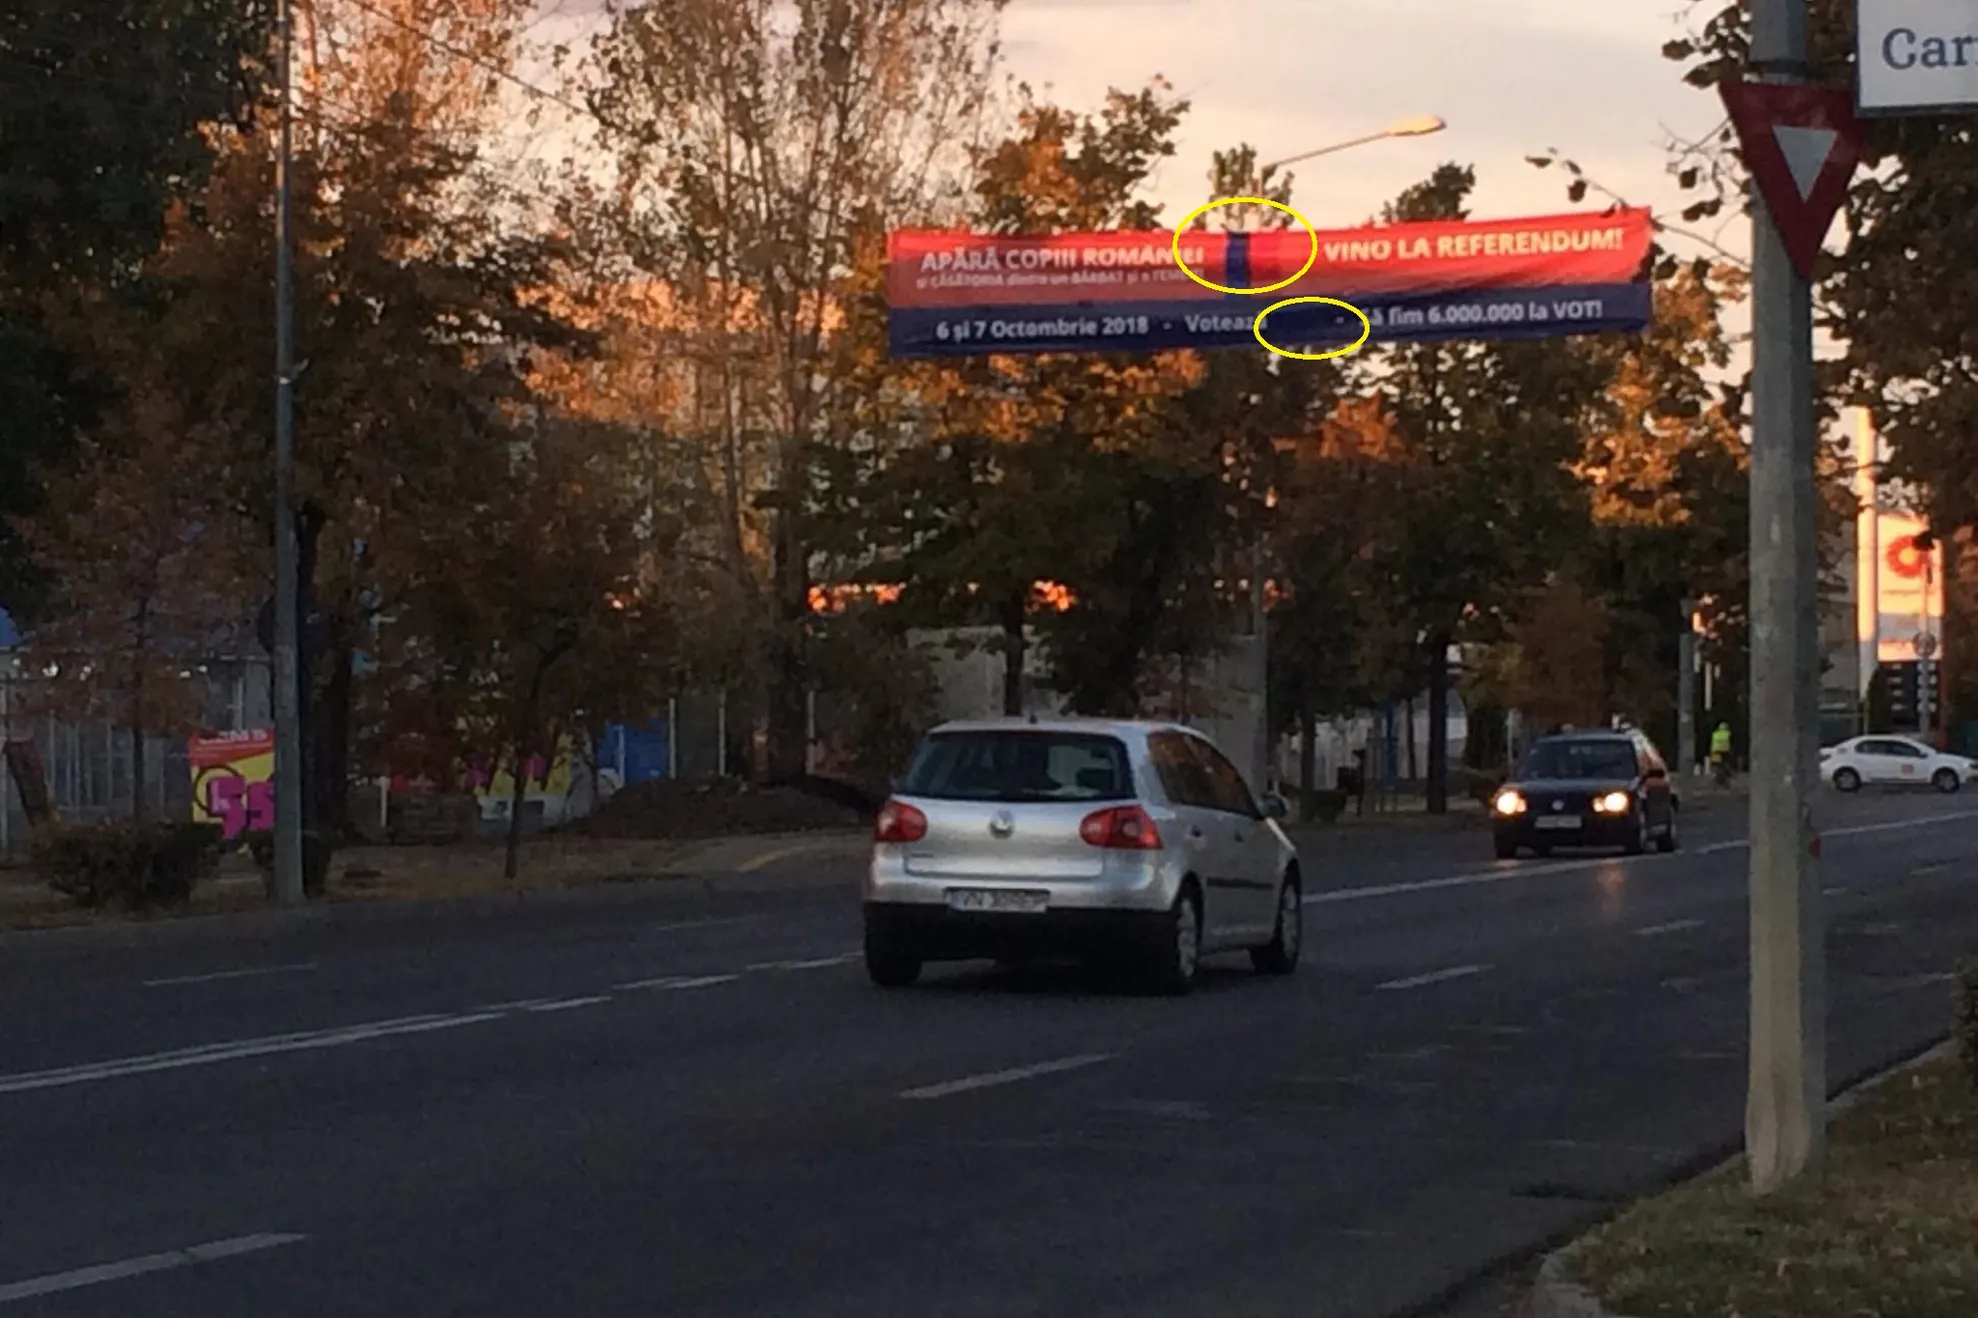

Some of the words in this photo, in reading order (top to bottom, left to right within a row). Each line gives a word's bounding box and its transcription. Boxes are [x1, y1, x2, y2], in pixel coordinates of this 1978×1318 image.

[1882, 28, 1978, 70] Car
[921, 246, 1001, 271] APĂRĂ
[1006, 247, 1077, 269] COPIII
[1324, 239, 1392, 262] VINO
[1397, 237, 1431, 259] LA
[1436, 227, 1624, 258] REFERENDUM!
[936, 321, 950, 340] 6
[973, 321, 987, 338] 7
[990, 318, 1098, 338] Octombrie
[1101, 315, 1149, 335] 2018
[1388, 306, 1424, 325] fim
[1428, 303, 1524, 324] 6.000.000
[1529, 302, 1548, 320] la
[1553, 300, 1603, 319] VOT!
